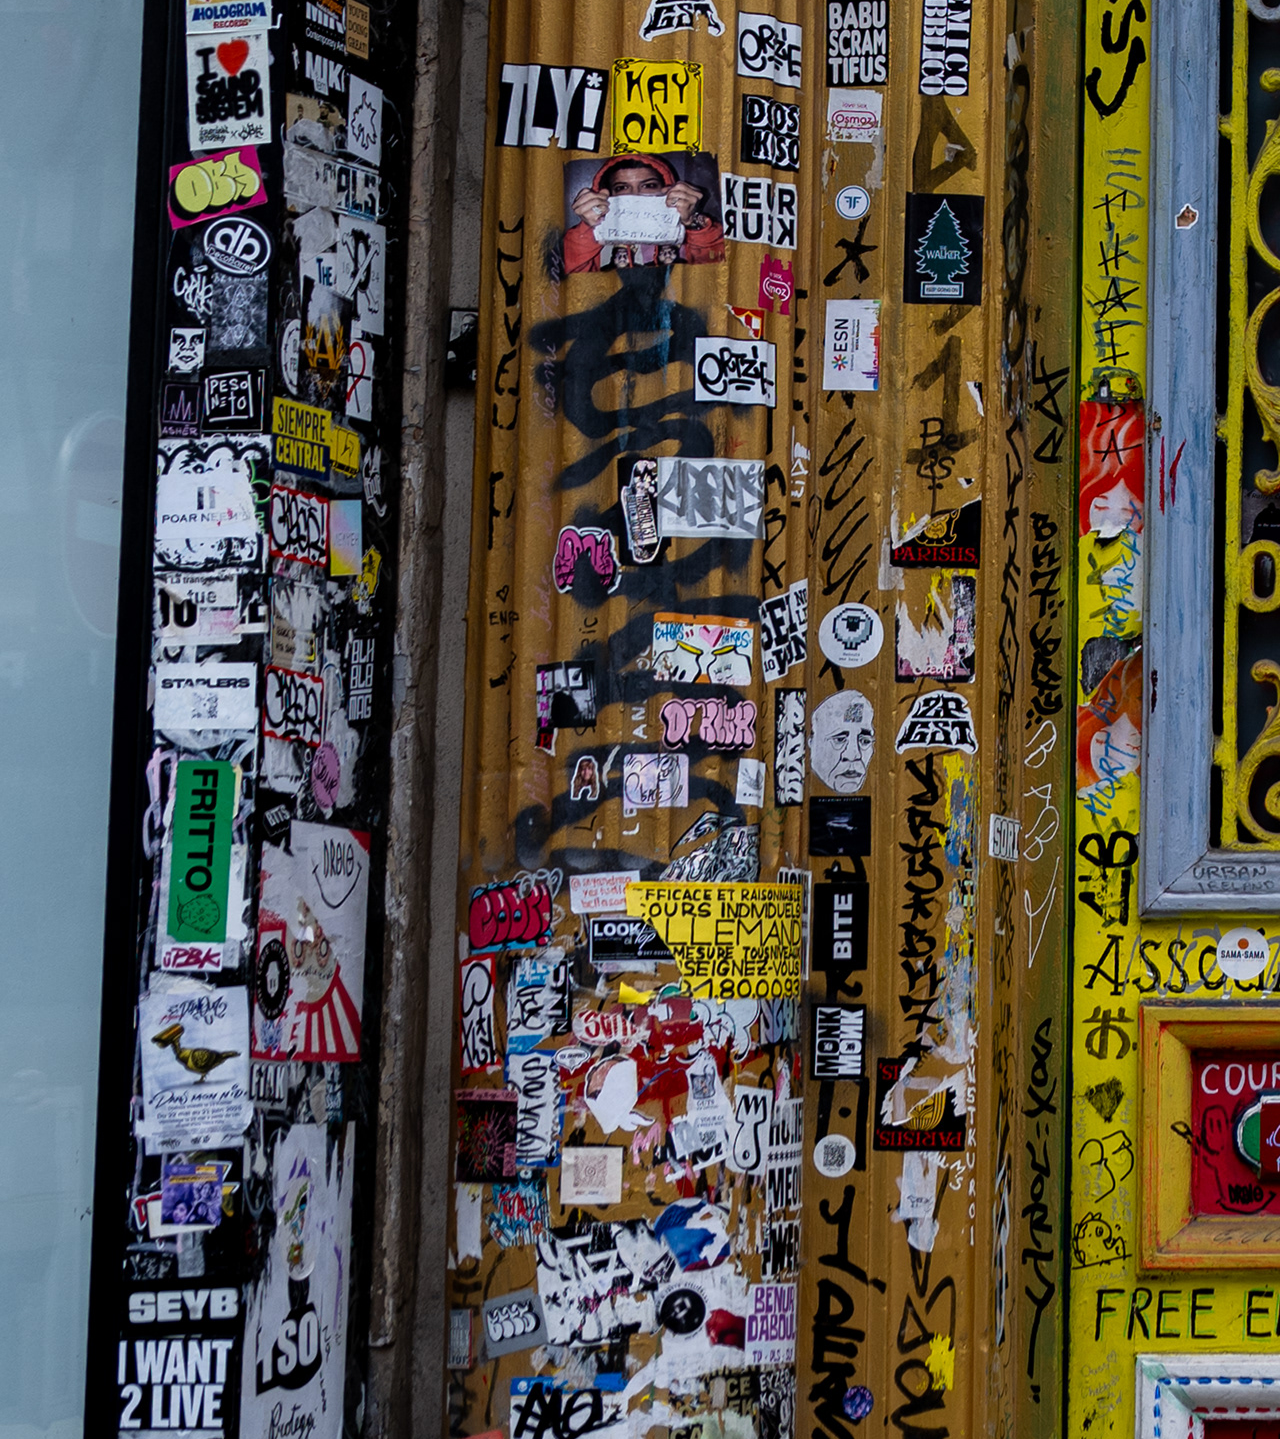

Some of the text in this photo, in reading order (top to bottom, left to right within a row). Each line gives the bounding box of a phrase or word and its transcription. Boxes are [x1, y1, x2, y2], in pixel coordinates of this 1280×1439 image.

[192, 3, 267, 21] HOLOGRAM
[830, 3, 886, 28] BABU
[829, 31, 887, 56] SCRAM
[624, 66, 690, 100] KAY
[828, 59, 887, 84] TIFUS
[622, 112, 689, 145] ONE
[831, 111, 876, 127] Osmoz
[833, 317, 849, 352] ESN
[278, 403, 327, 443] SIEMPRE
[274, 440, 327, 474] CENTRAL
[161, 677, 251, 690] STAPLERS
[186, 767, 218, 893] FRITTO
[717, 888, 801, 902] ET RAISONNABLE
[592, 922, 637, 938] LOOK
[666, 916, 801, 947] LLEMAND
[834, 893, 854, 960] BITE
[674, 946, 733, 961] MESURE
[128, 1288, 239, 1323] SEYB
[1094, 1287, 1217, 1344] FREE
[134, 1340, 233, 1384] WANT
[120, 1385, 223, 1429] 2 LIVE
